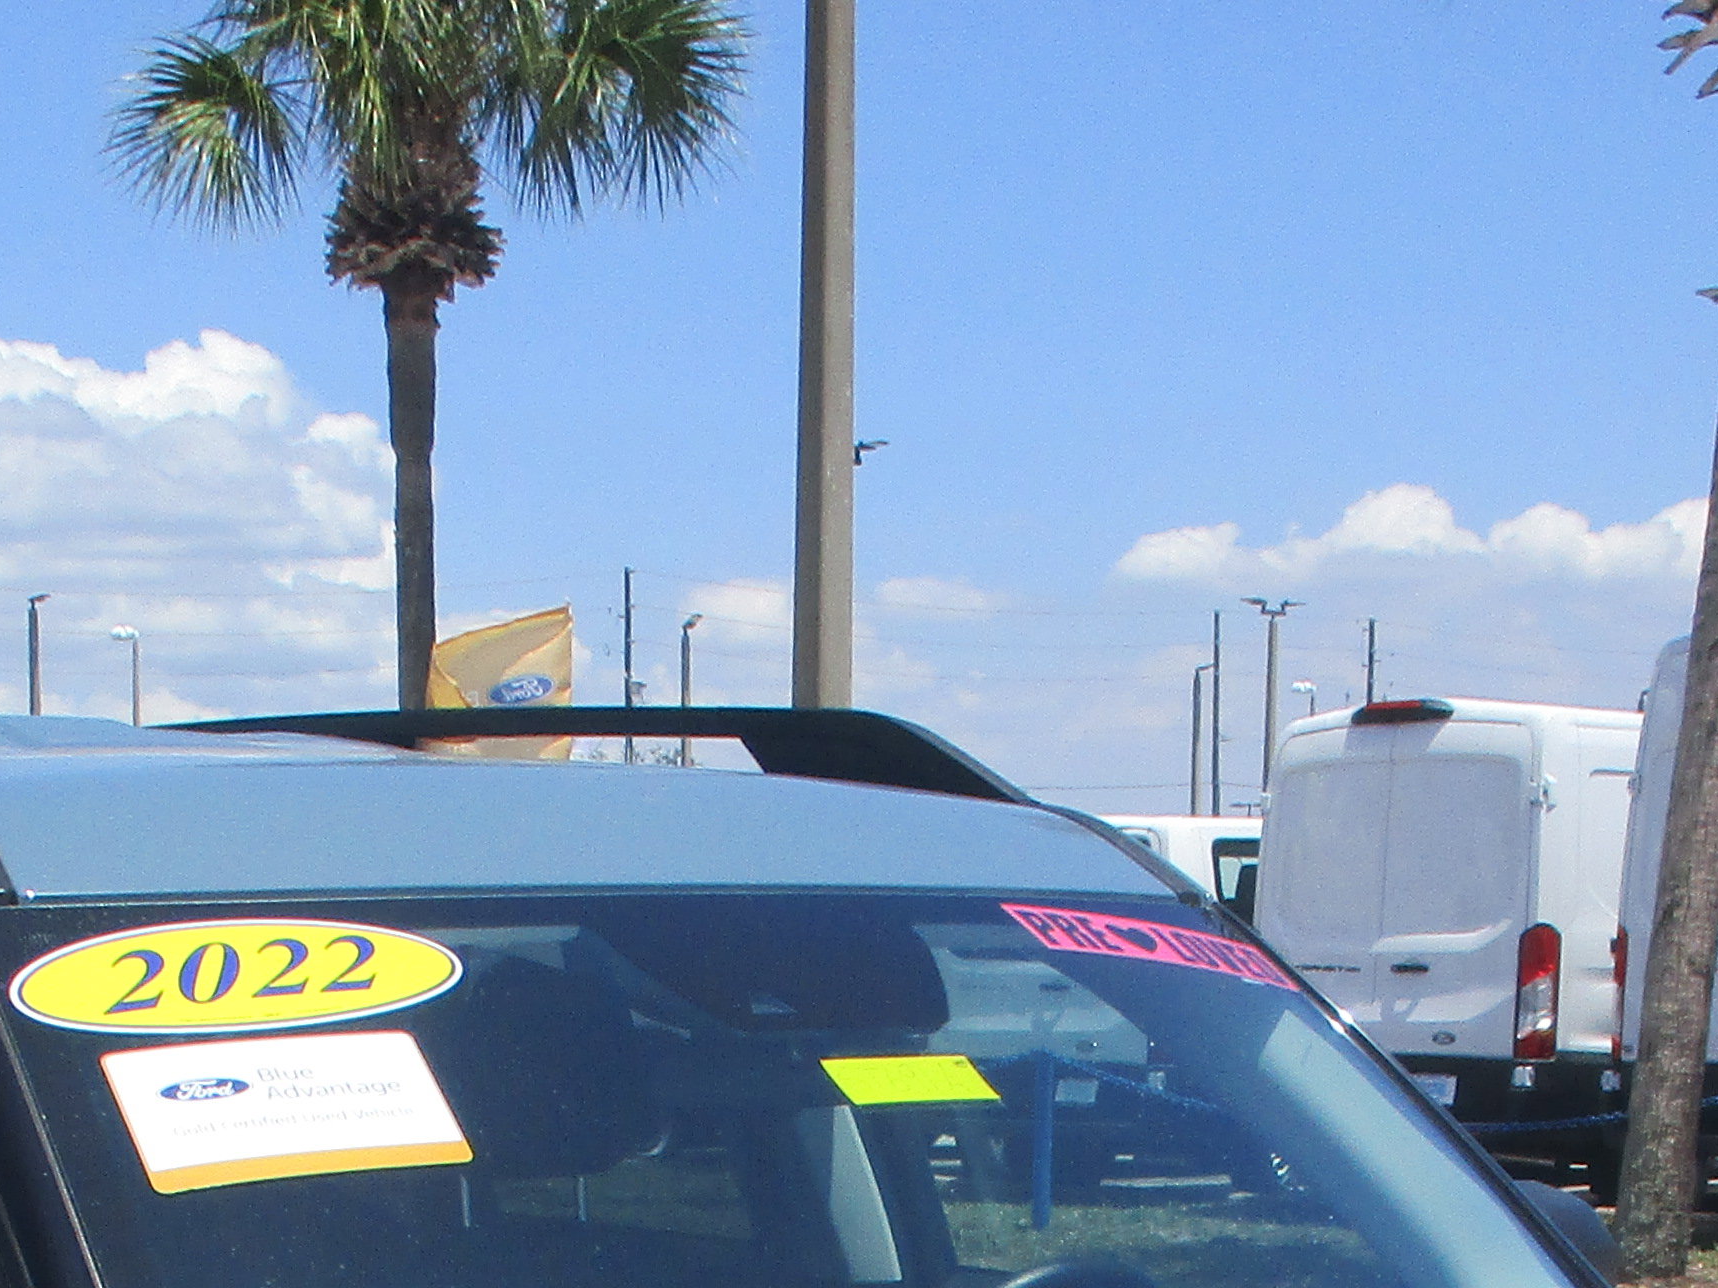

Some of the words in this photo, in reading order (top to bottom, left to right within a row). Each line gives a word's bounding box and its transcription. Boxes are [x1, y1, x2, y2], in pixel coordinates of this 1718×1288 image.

[1012, 908, 1124, 953] PRE
[1150, 927, 1288, 984] LOVED
[103, 934, 376, 1015] 2022
[256, 1066, 315, 1083] Blue
[174, 1078, 238, 1101] Ford
[267, 1078, 402, 1101] Advantage
